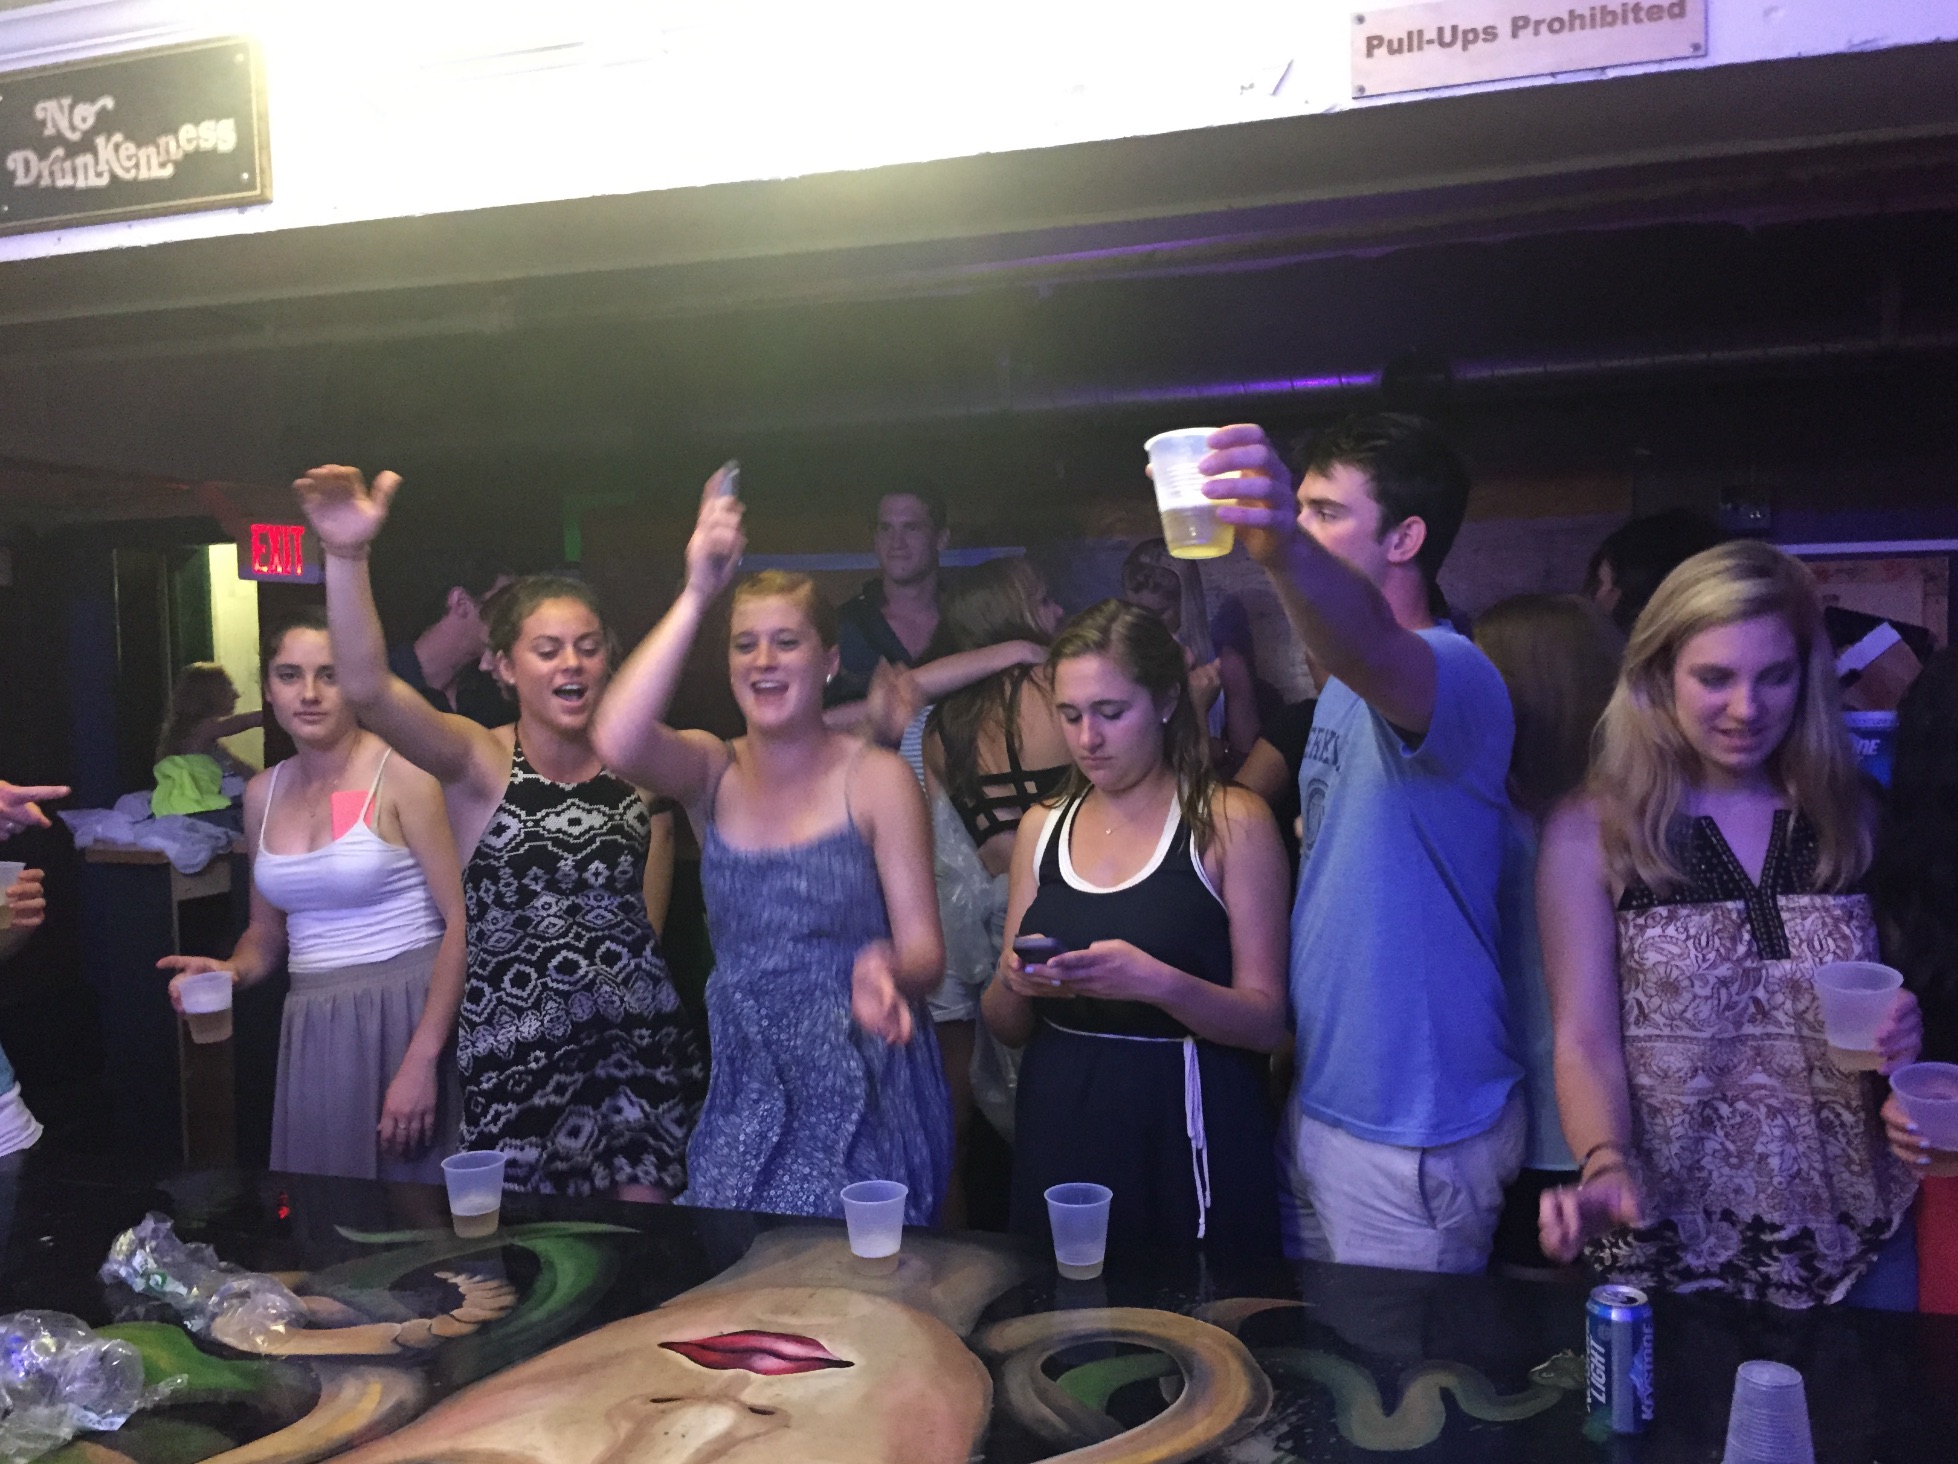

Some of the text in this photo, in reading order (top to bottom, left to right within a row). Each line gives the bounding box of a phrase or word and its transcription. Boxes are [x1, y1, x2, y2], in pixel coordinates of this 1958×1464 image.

[1366, 0, 1687, 58] Pull-Ups Prohibited
[34, 94, 115, 141] No
[250, 523, 305, 576] EXIT
[1589, 1333, 1606, 1405] LIGHT
